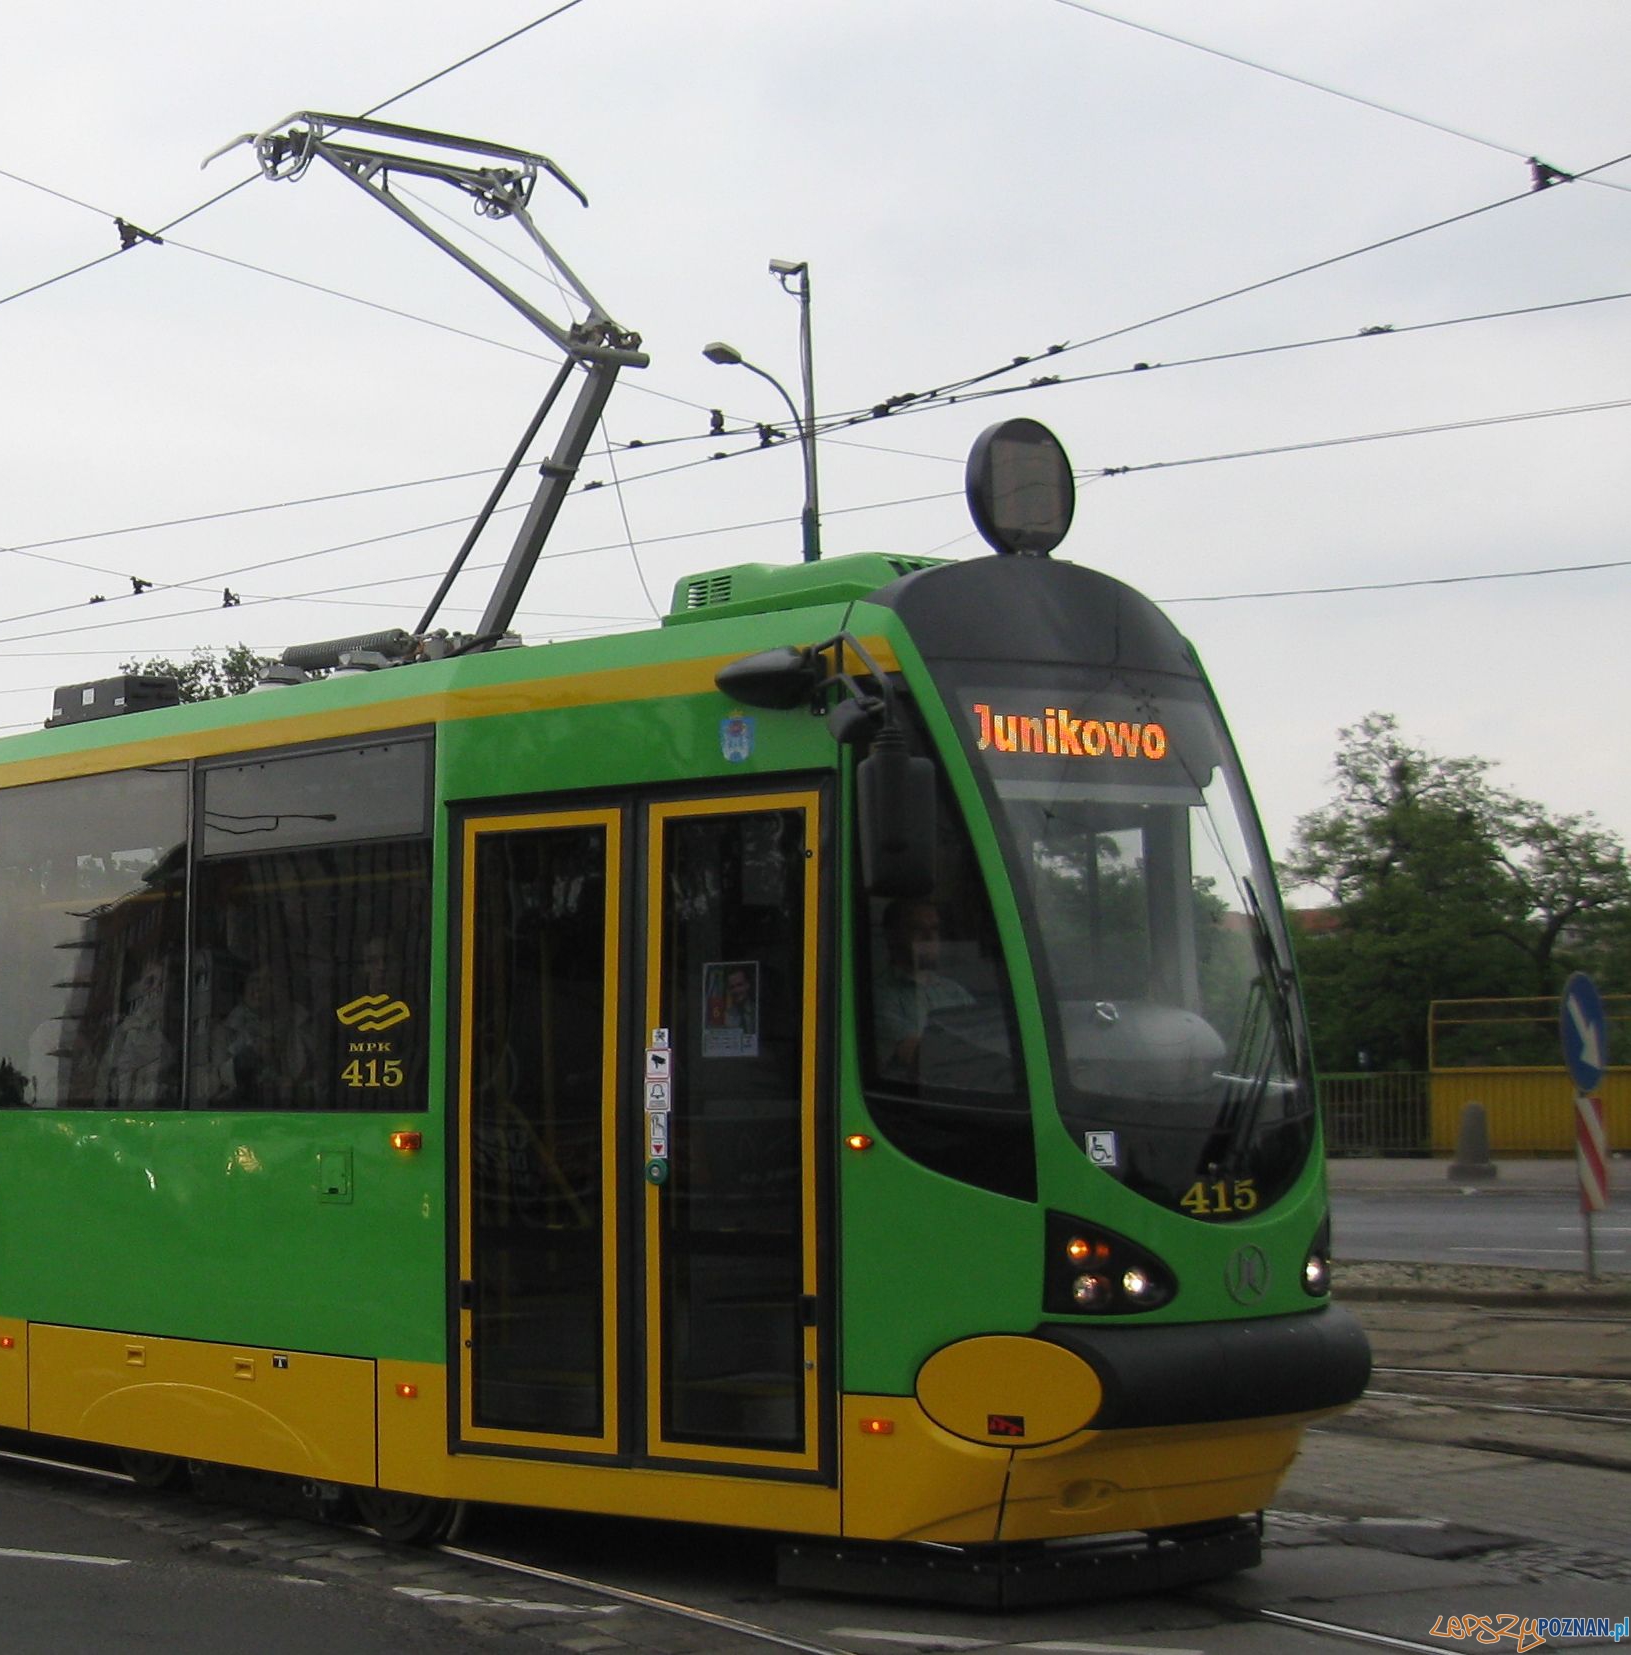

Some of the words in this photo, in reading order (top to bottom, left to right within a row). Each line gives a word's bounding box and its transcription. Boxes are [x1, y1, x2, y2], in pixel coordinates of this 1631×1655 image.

[972, 703, 1166, 760] Junikowo
[349, 1042, 391, 1052] MPK
[341, 1059, 404, 1087] 415
[1180, 1179, 1258, 1214] 415
